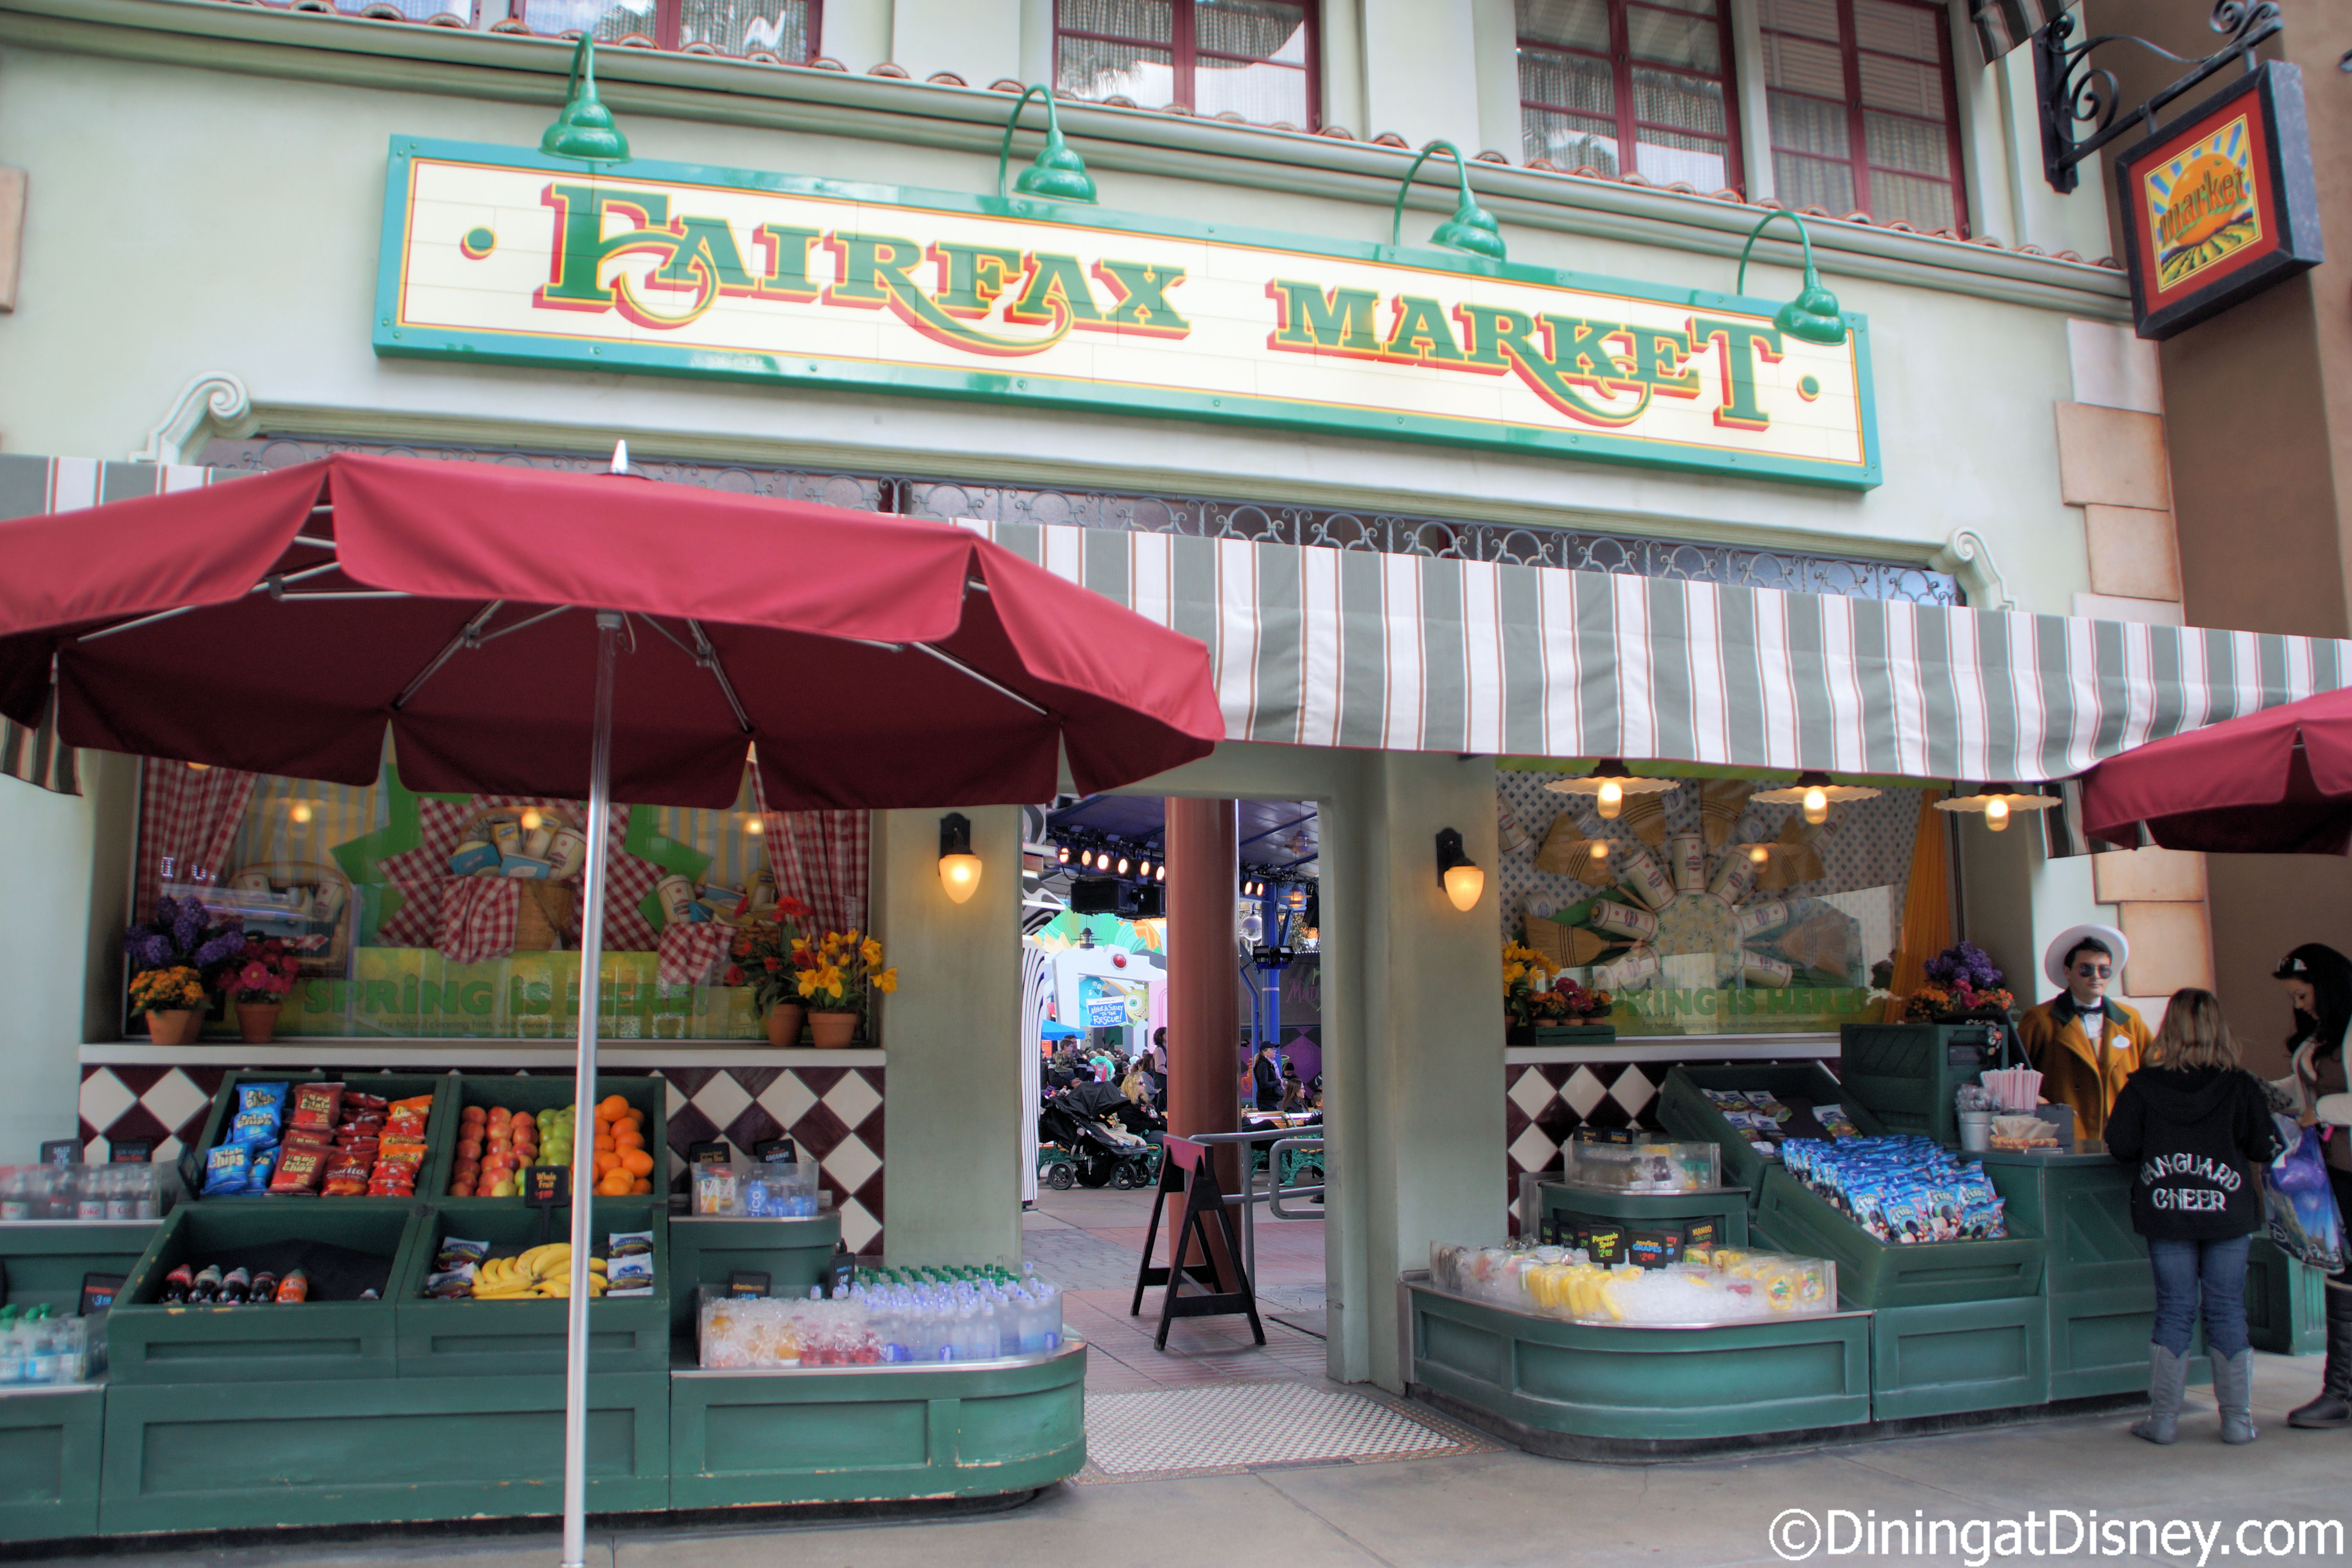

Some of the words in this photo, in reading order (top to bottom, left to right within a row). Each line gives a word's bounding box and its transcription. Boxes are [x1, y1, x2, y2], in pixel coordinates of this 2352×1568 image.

[2159, 165, 2248, 245] market
[532, 183, 1192, 358] FAIRFAX
[1265, 278, 1784, 428] MARKET
[567, 981, 709, 1016] HERE!
[1607, 983, 1716, 1016] PRiNG
[1768, 987, 1863, 1015] HERE!
[1093, 1011, 1123, 1025] RESCUE!
[766, 1151, 789, 1161] COCONUT
[535, 1171, 557, 1181] Whole
[2140, 1152, 2242, 1192] VANGUARD
[538, 1180, 554, 1188] Fruit
[2152, 1187, 2227, 1212] CHEER
[1692, 1225, 1713, 1236] MANGO
[1592, 1231, 1619, 1243] Pineapple
[1599, 1240, 1615, 1249] Spear
[1632, 1243, 1662, 1254] GRAPES
[732, 1283, 764, 1292] vitaminwater
